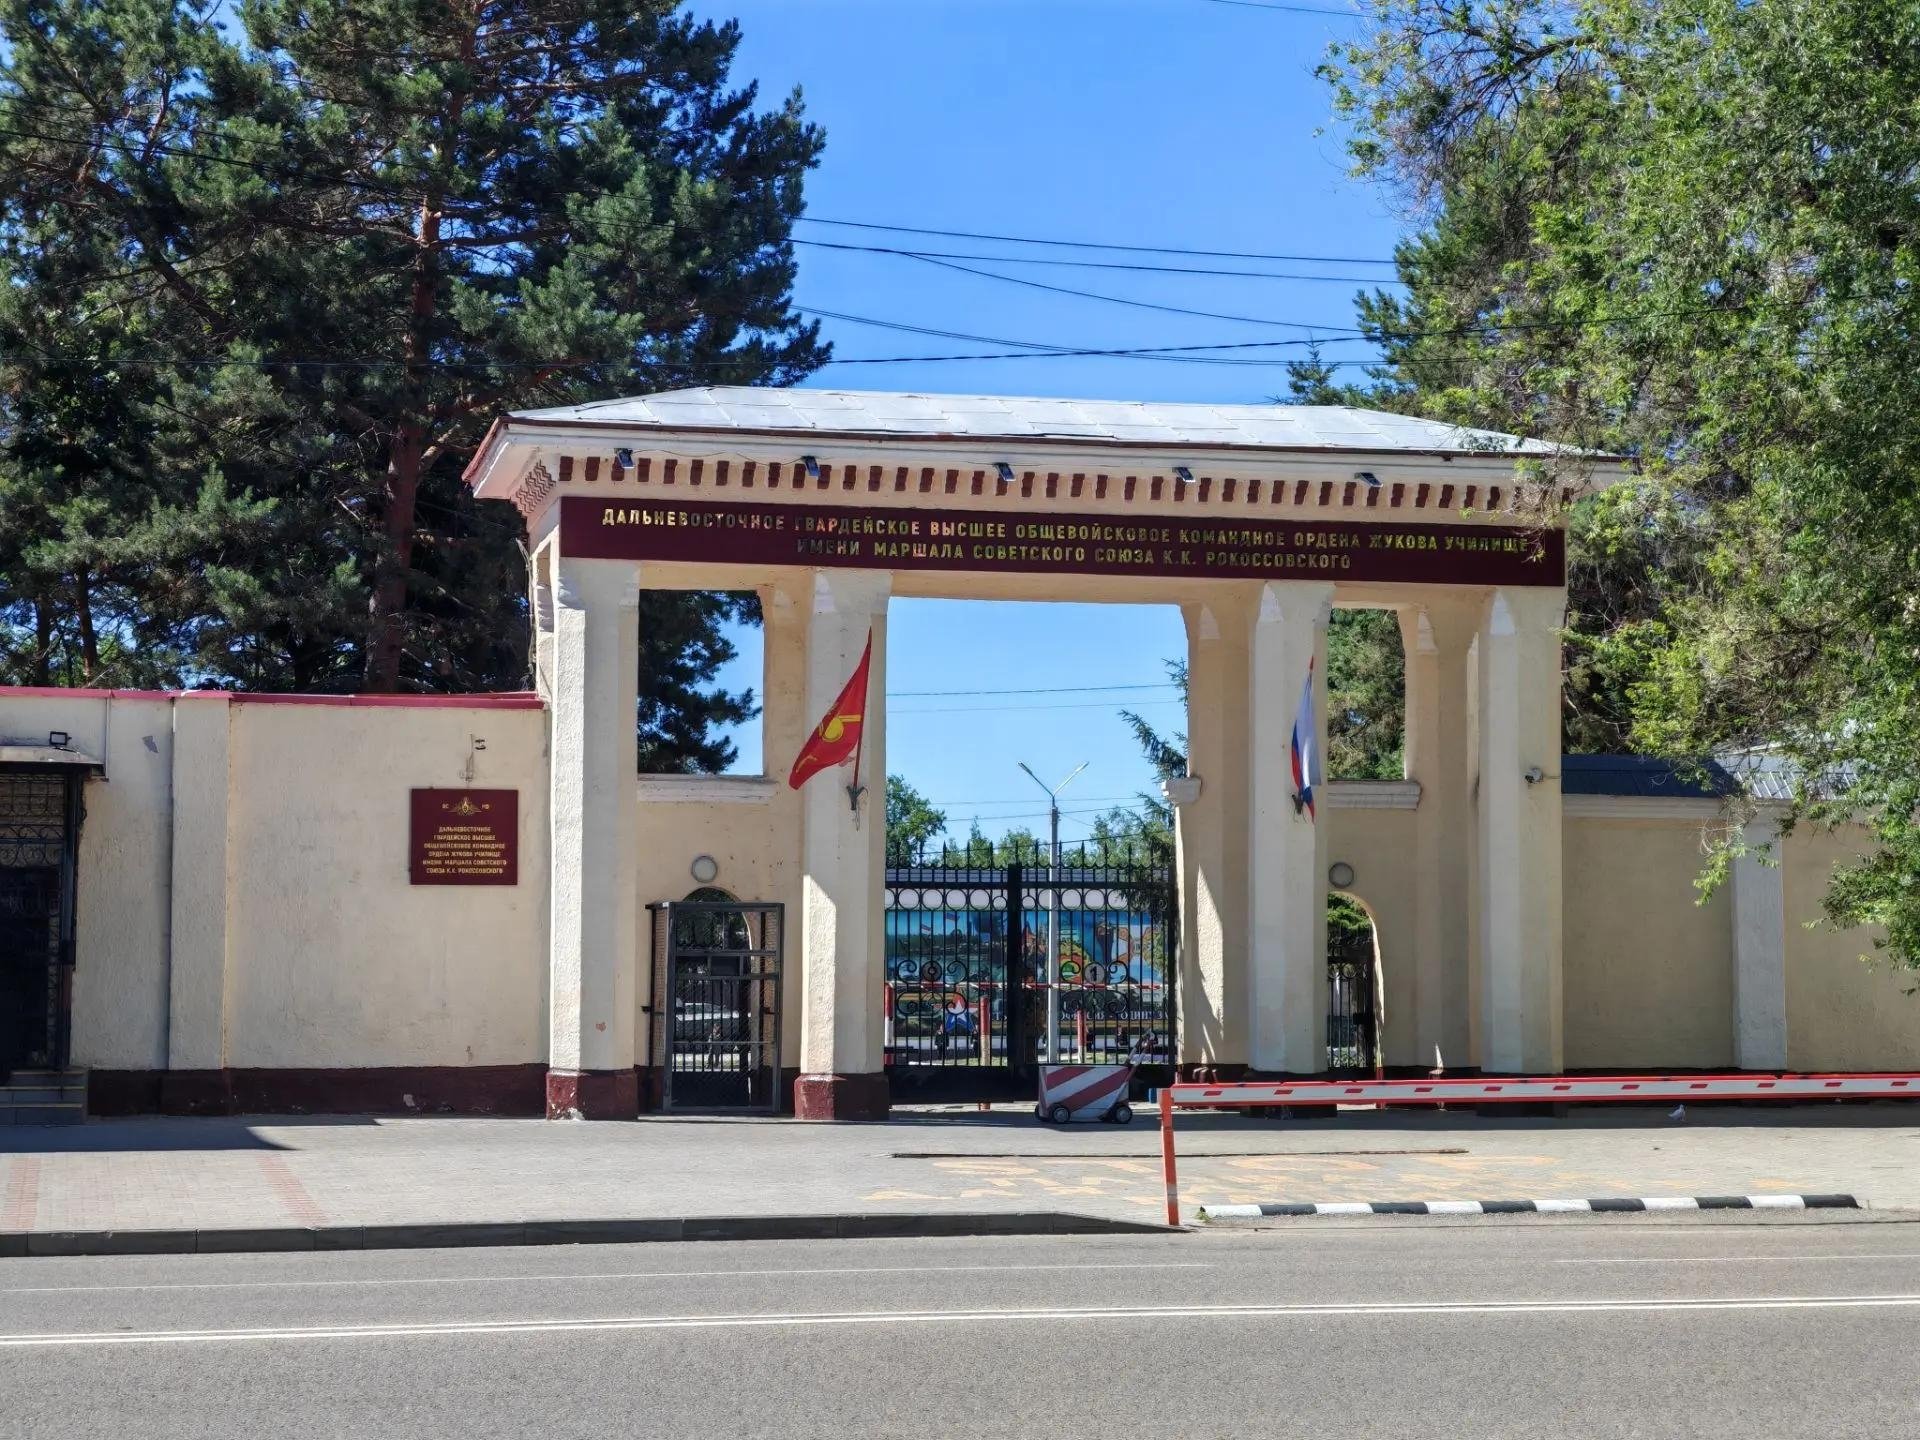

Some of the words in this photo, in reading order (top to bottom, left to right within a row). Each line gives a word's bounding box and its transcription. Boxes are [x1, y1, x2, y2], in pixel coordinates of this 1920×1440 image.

[602, 508, 785, 530] ДАЛЬНЕВОСТОЧНОЕ
[793, 516, 920, 535] ГВАРДЕЙСКОЕ
[930, 520, 1006, 538] ВЫСШЕЕ
[1015, 523, 1170, 543] ОБЩЕВОЙСКОВОЕ
[1179, 529, 1285, 547] КОМАНДНОЕ
[1294, 532, 1361, 549] ОРДЕНА
[1369, 534, 1437, 550] ЖУКОВА
[1445, 536, 1528, 553] УЧИЛИЩЕ
[797, 538, 861, 556] ИМЕНИ
[874, 541, 964, 559] МАРШАЛА
[973, 544, 1085, 562] СОВЕТСКОГО
[1095, 547, 1155, 564] СОЮЗА
[1163, 550, 1197, 566] К.К.
[1206, 551, 1351, 569] РОКОССОВСКОГО
